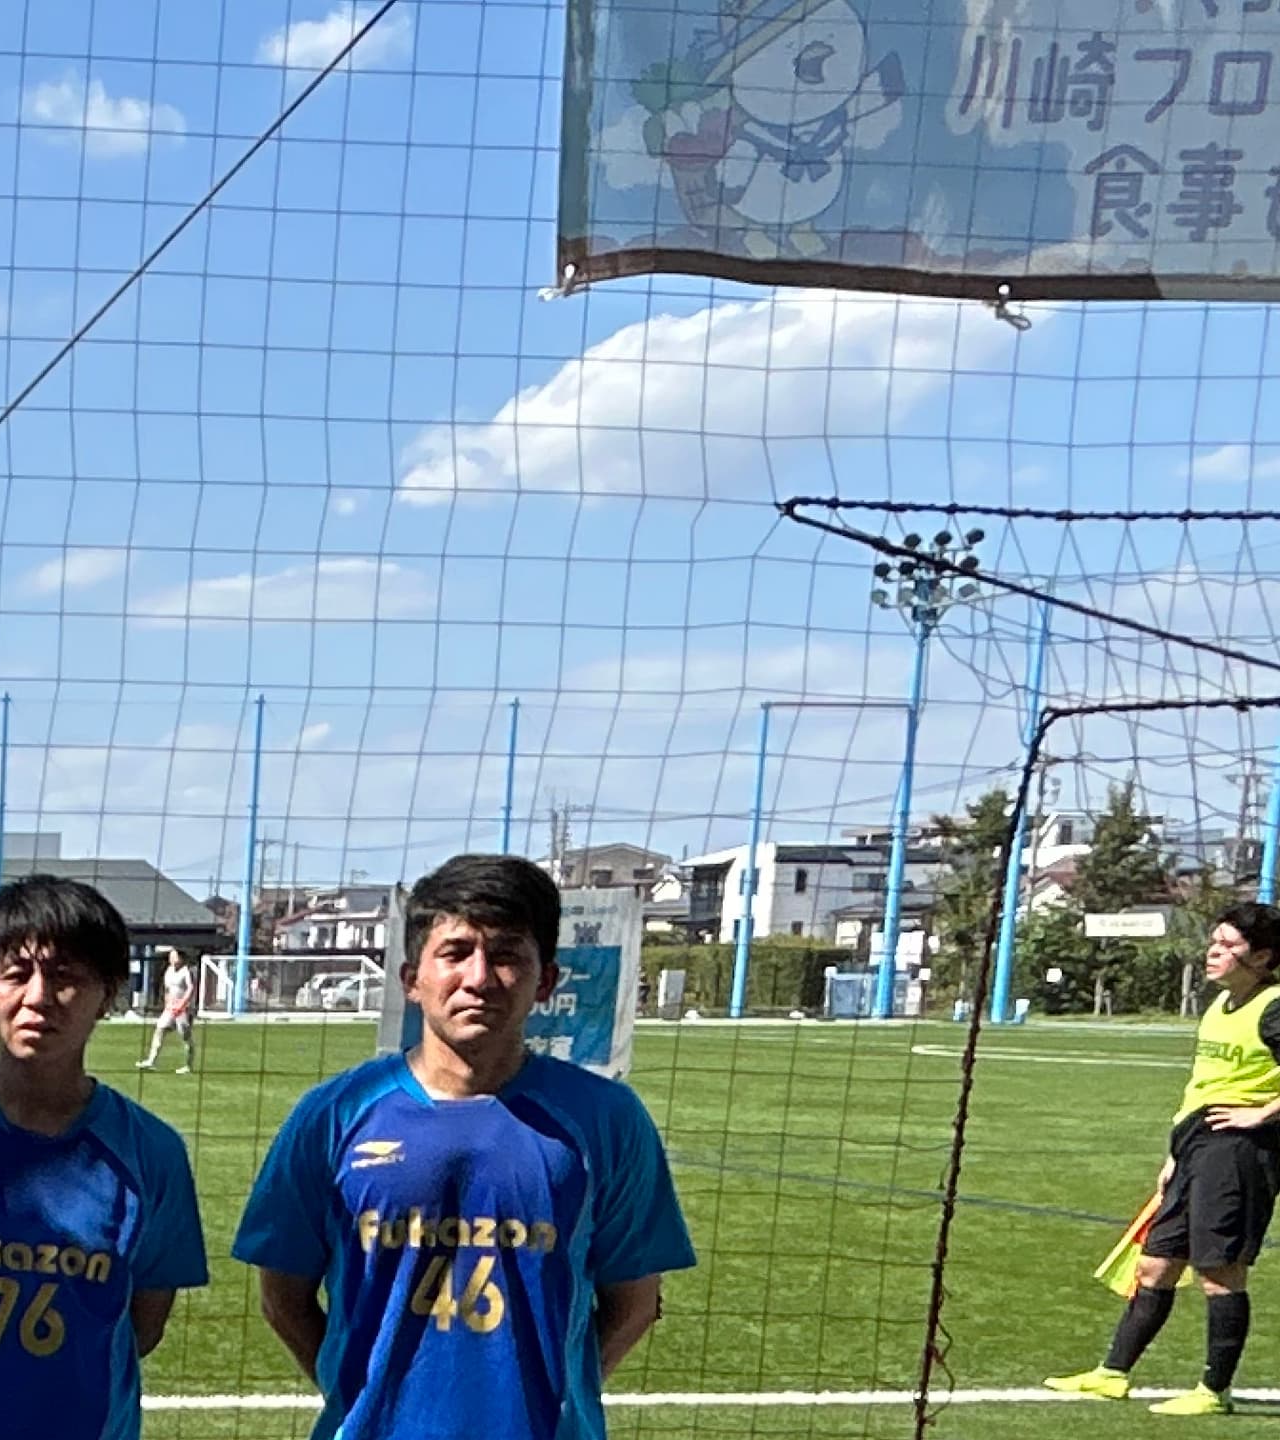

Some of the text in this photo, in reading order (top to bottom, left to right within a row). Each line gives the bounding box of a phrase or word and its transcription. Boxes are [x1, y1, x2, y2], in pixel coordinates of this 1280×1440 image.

[1084, 142, 1280, 242] 食事
[358, 1206, 558, 1254] Fukazon
[410, 1255, 506, 1334] 46
